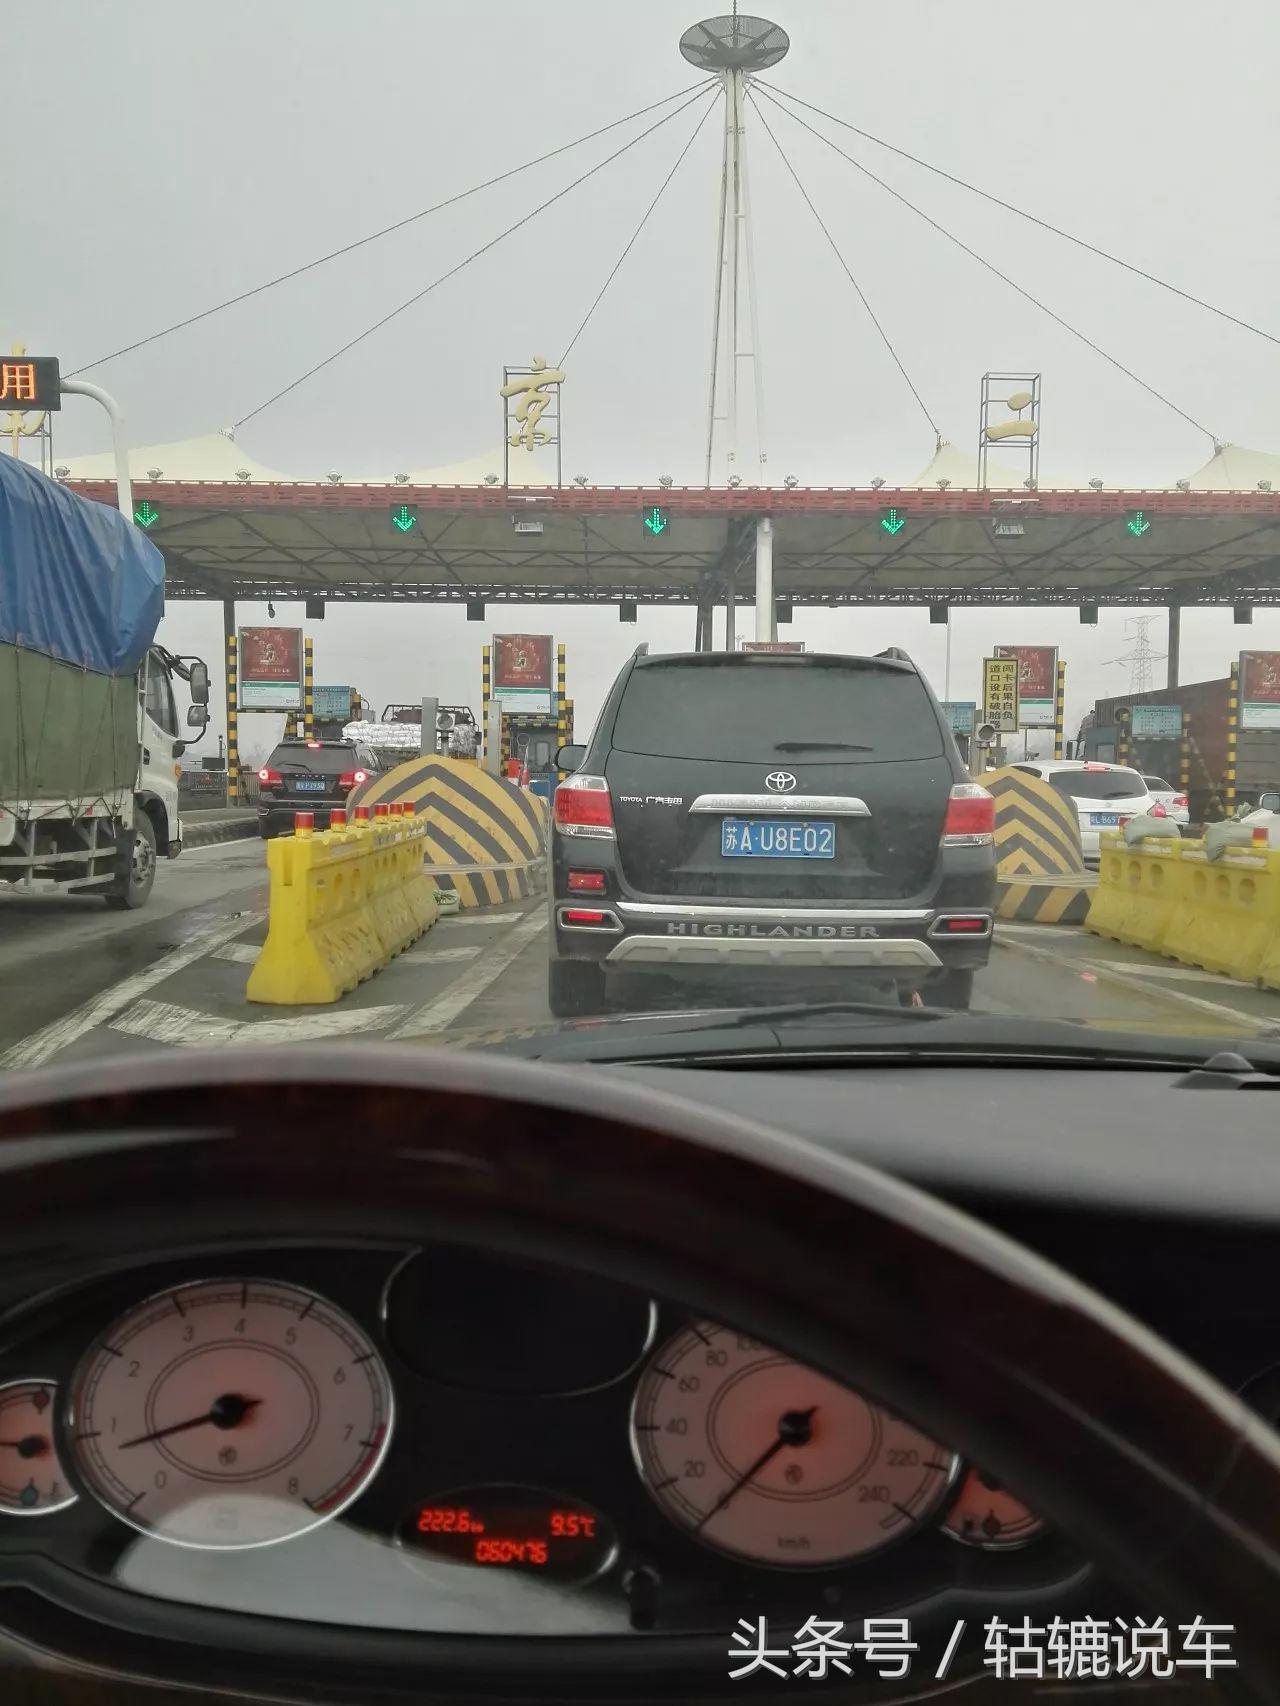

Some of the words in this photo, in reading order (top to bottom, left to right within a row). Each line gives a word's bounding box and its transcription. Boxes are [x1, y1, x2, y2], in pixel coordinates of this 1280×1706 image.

[0, 364, 35, 400] 用
[500, 354, 566, 452] 京
[724, 826, 833, 853] 苏A·U8E02
[667, 922, 880, 938] HIGHLANDER
[182, 1325, 194, 1343] 3
[234, 1318, 246, 1334] 4
[286, 1326, 296, 1345] 5
[704, 1350, 728, 1368] 80
[128, 1361, 141, 1378] 2
[334, 1367, 346, 1385] 6
[678, 1377, 701, 1393] 60
[111, 1417, 117, 1433] 1
[343, 1425, 354, 1441] 7
[665, 1418, 688, 1434] 40
[888, 1449, 919, 1466] 220
[684, 1460, 705, 1478] 20
[155, 1471, 167, 1489] 0
[288, 1477, 299, 1496] 8
[858, 1485, 891, 1503] 240
